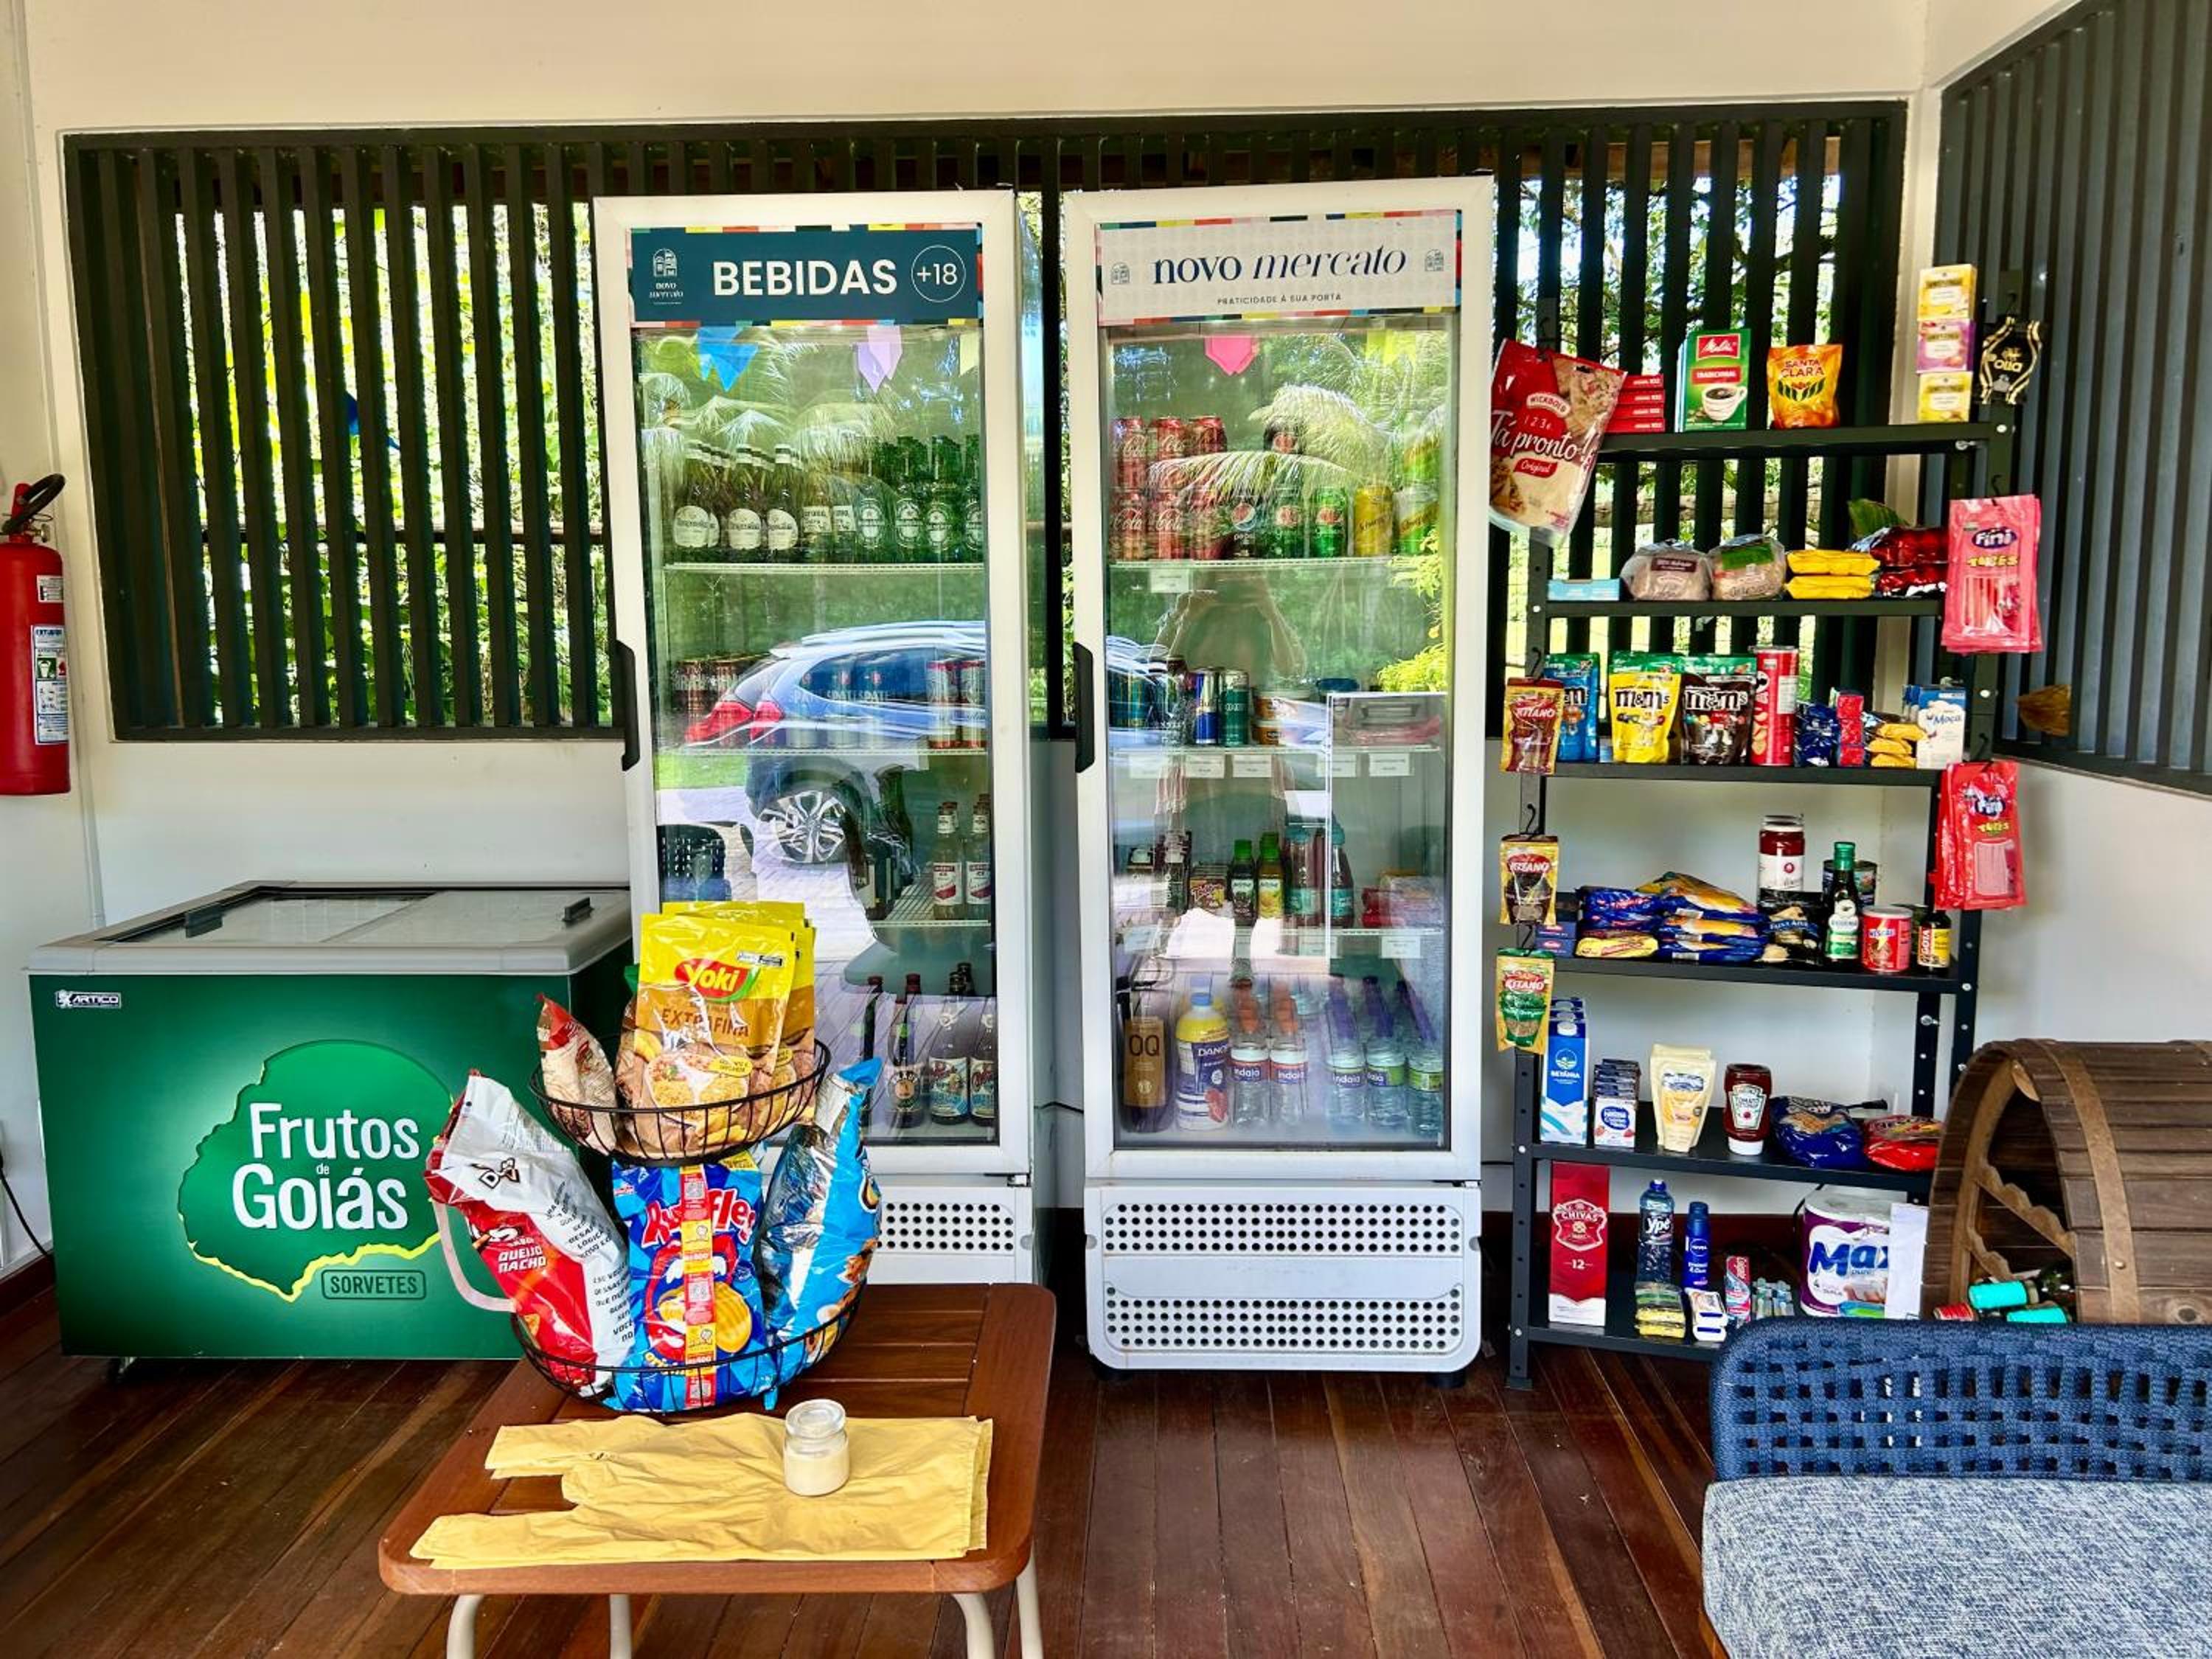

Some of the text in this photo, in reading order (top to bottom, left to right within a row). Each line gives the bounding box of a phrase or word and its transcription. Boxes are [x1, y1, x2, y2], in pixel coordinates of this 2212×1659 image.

[1152, 244, 1407, 285] novo mercato
[712, 259, 898, 296] BEBIDAS
[917, 262, 958, 286] +18
[1217, 296, 1278, 305] PRATICIDADE
[1311, 293, 1342, 302] PORTA
[1781, 366, 1825, 378] CLARA
[1785, 359, 1820, 368] SANTA
[1520, 460, 1553, 474] Original
[682, 962, 740, 992] Yoki
[249, 1102, 420, 1161] Frutos
[316, 1163, 330, 1175] de
[232, 1163, 409, 1231] Goiás
[1561, 1210, 1599, 1222] CHIVAS
[498, 1245, 543, 1262] QUEIJO
[498, 1256, 548, 1274] NACHO
[1571, 1258, 1585, 1270] 12
[330, 1275, 418, 1295] SORVETES
